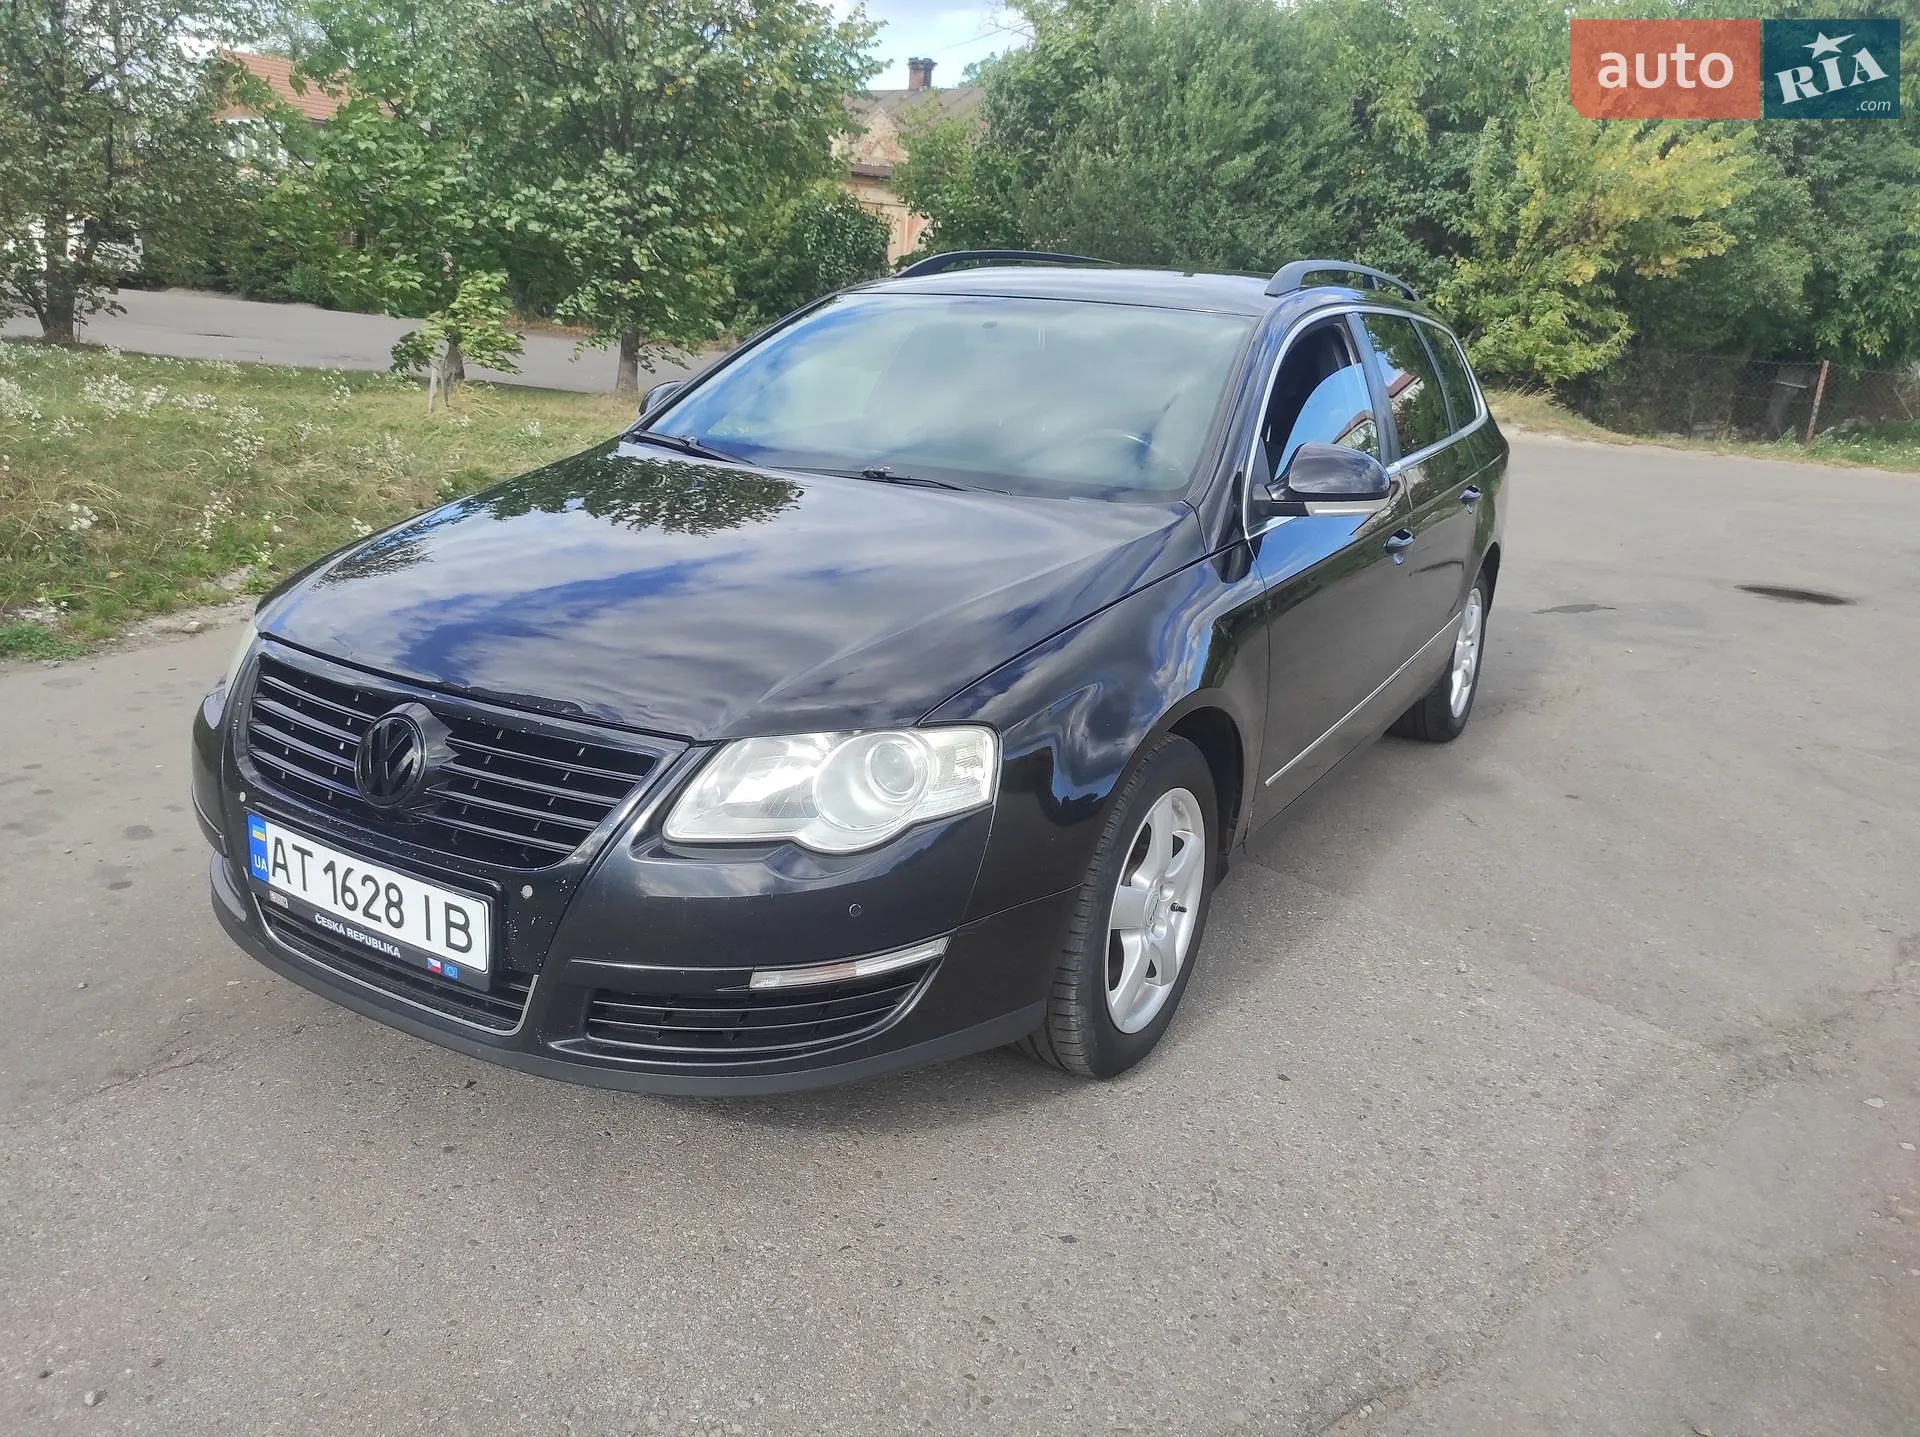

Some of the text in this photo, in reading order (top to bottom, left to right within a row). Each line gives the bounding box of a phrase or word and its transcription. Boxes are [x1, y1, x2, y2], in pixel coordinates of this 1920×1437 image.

[254, 853, 268, 873] UA
[271, 836, 473, 954] AT 1628 IB
[314, 911, 401, 958] ČESKÁ REPUBLIKA
